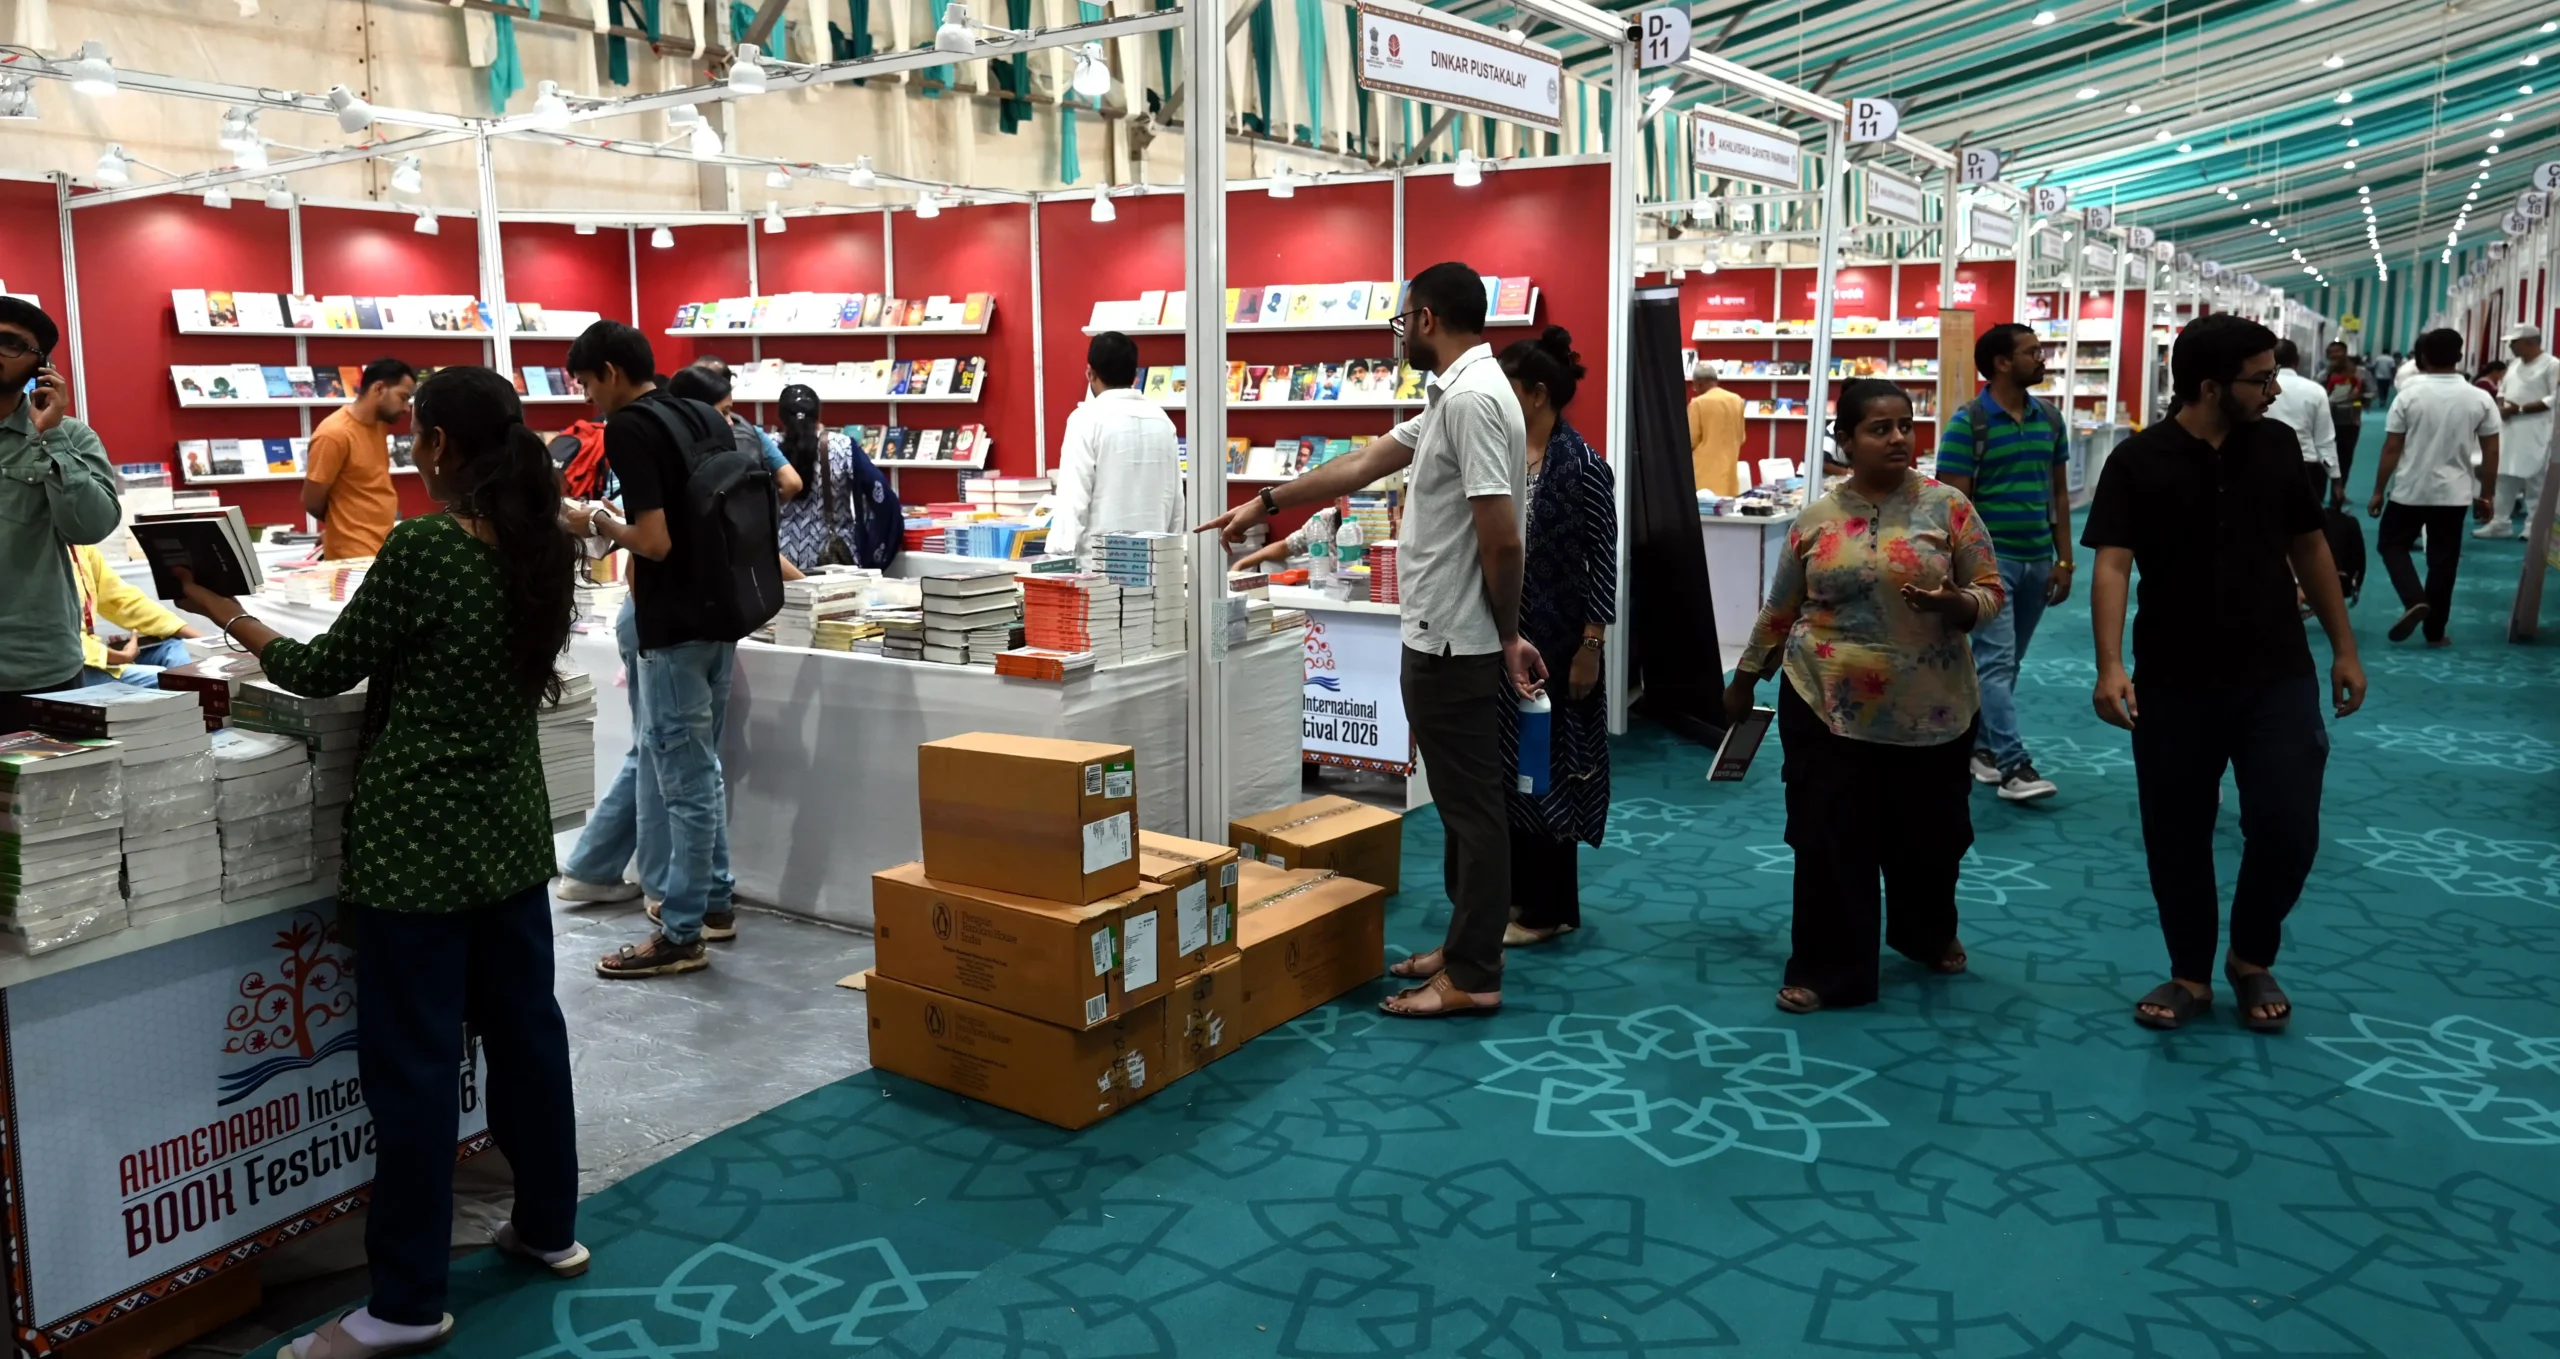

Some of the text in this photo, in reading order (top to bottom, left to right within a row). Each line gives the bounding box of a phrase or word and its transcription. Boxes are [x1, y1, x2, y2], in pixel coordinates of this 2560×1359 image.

[1649, 15, 1672, 37] D-
[1648, 37, 1669, 60] 11
[1431, 51, 1469, 74] DINKAR
[1471, 61, 1527, 89] PUSTAKALAY
[1859, 103, 1881, 119] D-
[1858, 121, 1878, 137] 11
[1967, 152, 1985, 166] D-
[1967, 166, 1984, 180] 11
[2547, 176, 2560, 189] 4
[2040, 189, 2054, 201] D-
[2040, 200, 2055, 211] 10
[2091, 208, 2103, 219] D-
[2526, 204, 2542, 215] 48
[2092, 218, 2103, 227] 10
[1303, 693, 1377, 719] International
[1303, 715, 1378, 747] tival 2026
[119, 1093, 301, 1198] AHMEDABAD
[122, 1120, 378, 1258] BOOK Festiva
